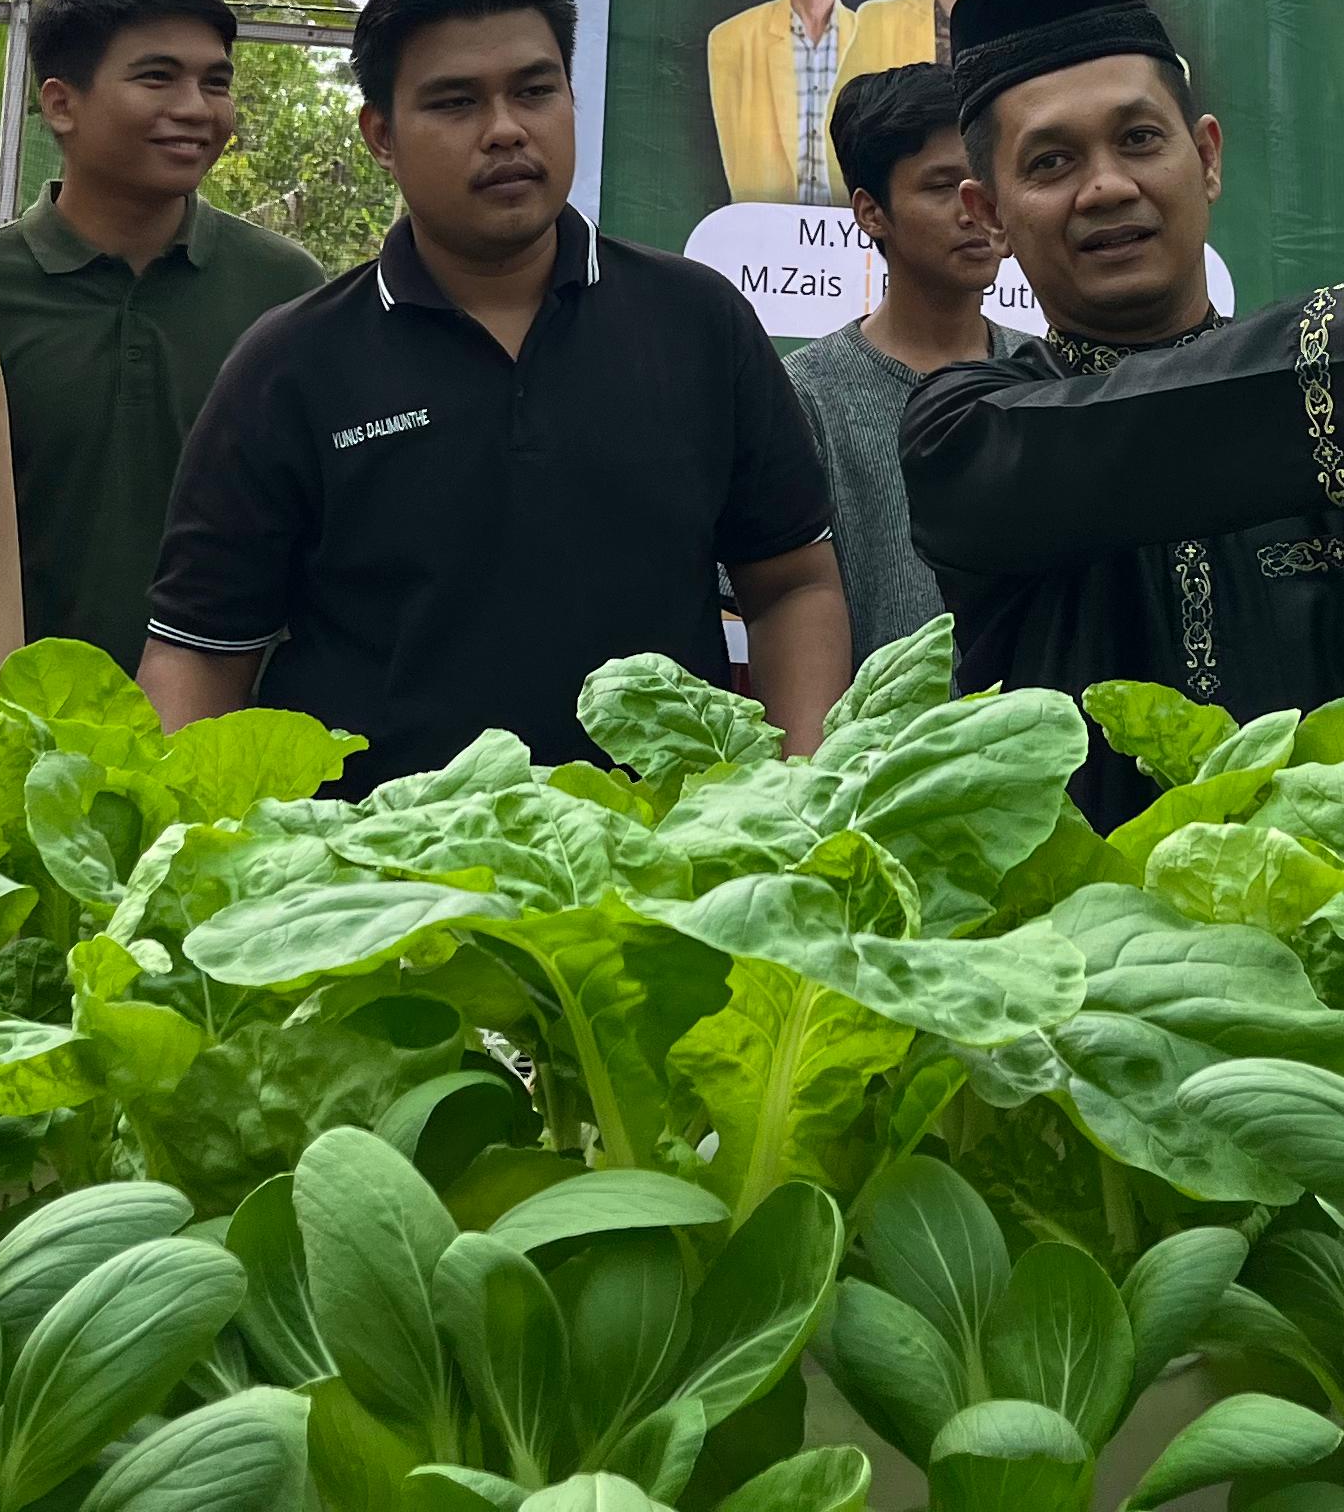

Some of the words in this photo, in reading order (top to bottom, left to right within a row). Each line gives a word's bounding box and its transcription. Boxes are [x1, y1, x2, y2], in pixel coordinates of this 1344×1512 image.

[798, 218, 873, 248] M.Yu
[740, 264, 842, 296] M.Zais
[332, 426, 365, 449] YUNUS
